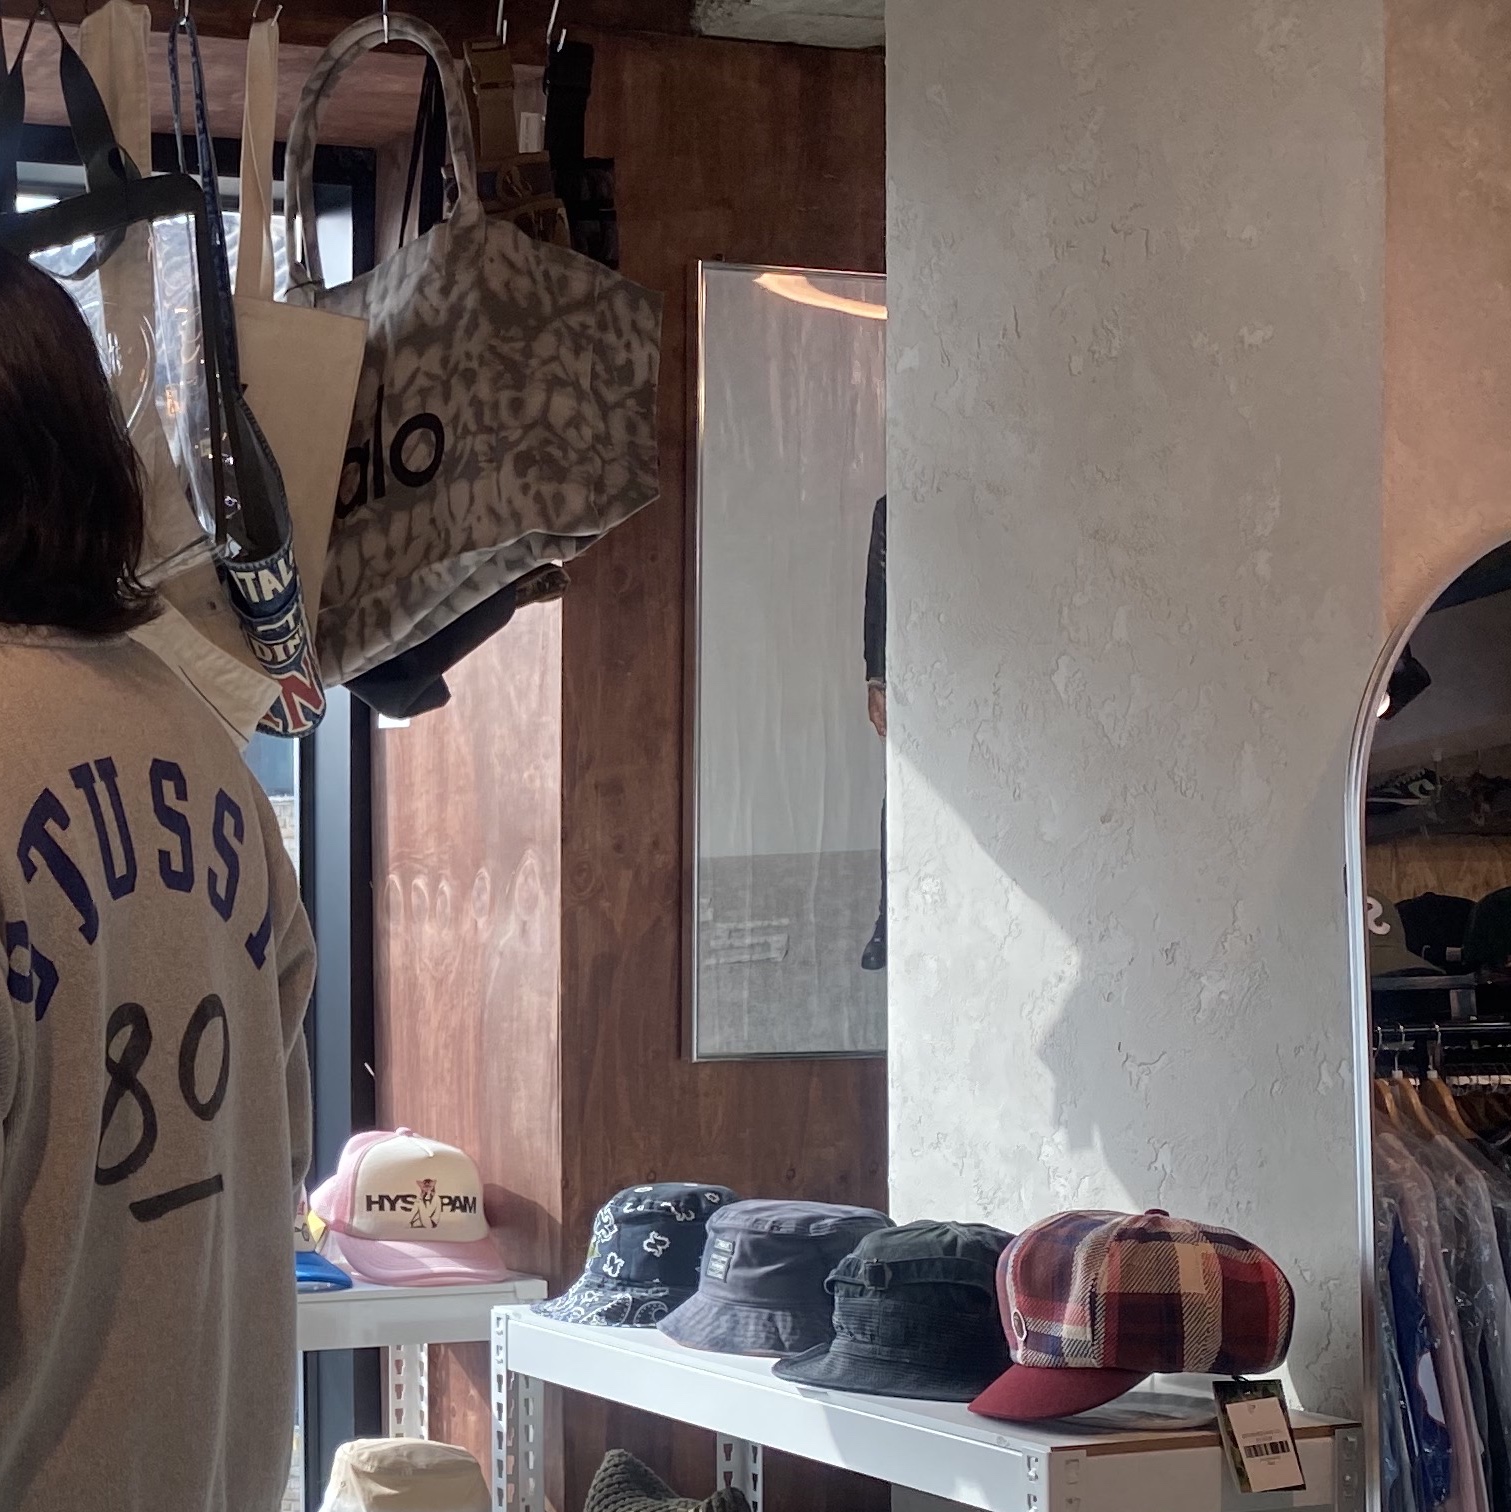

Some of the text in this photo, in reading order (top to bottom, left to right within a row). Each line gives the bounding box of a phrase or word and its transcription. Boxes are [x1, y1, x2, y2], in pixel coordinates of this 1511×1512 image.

[335, 384, 445, 520] alo
[94, 993, 230, 1186] 80
[366, 1194, 477, 1214] HYS PAM
